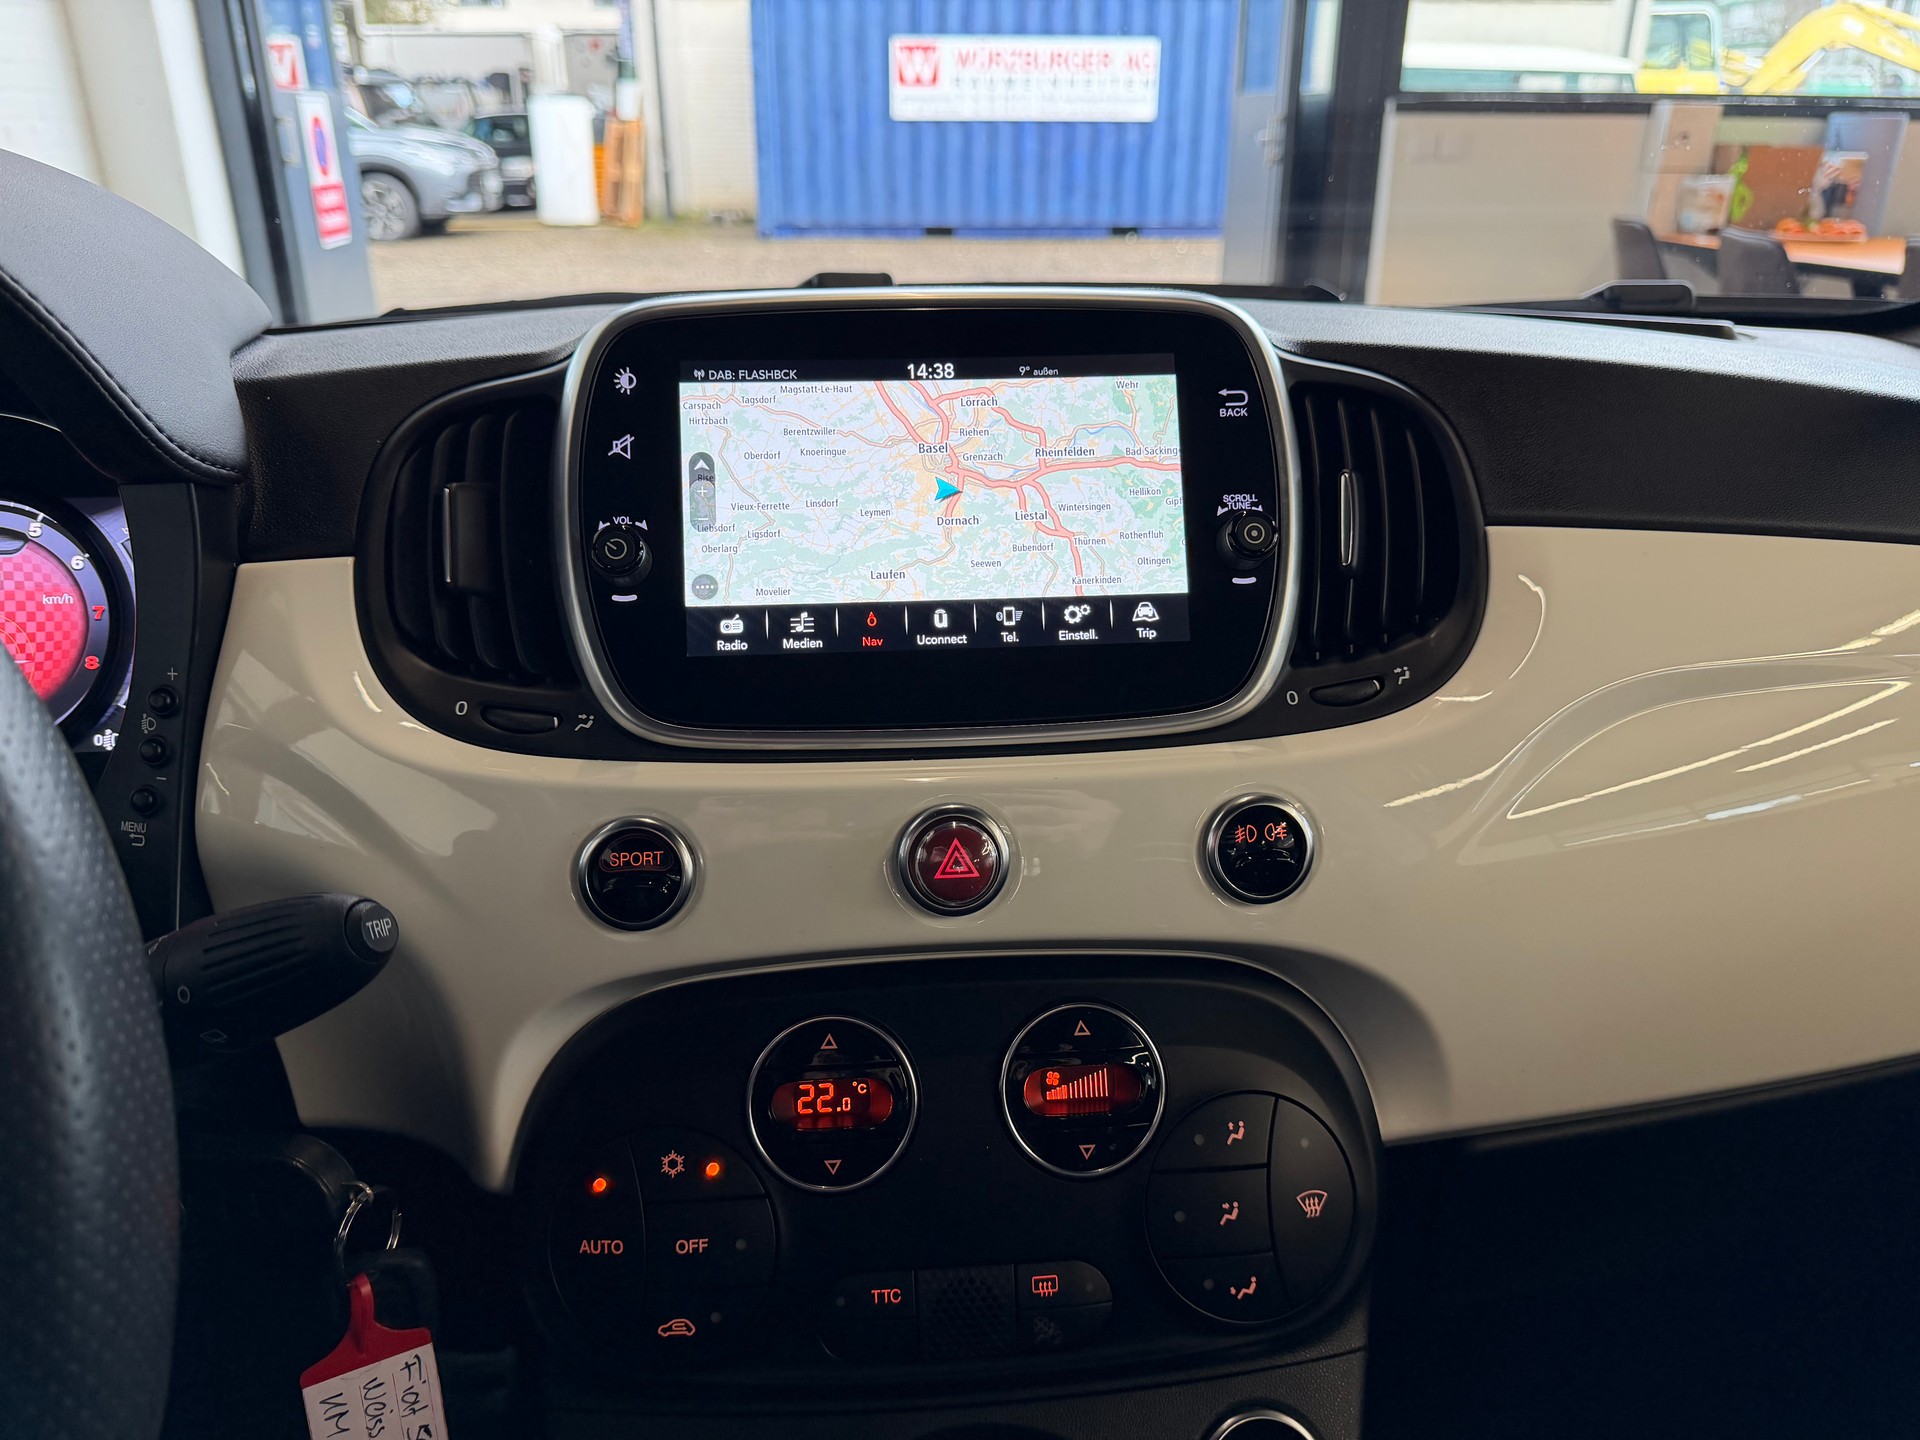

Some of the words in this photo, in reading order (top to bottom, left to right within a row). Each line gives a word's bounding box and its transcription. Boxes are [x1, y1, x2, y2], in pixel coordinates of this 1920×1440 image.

[708, 370, 736, 380] DAB:
[738, 369, 798, 380] FLASHBCK
[907, 362, 955, 379] 14:38
[1018, 366, 1030, 376] 9°
[1033, 366, 1059, 376] außen
[1116, 380, 1139, 389] Wehr
[780, 385, 852, 395] Magstatt-Le-Haut
[741, 395, 776, 405] Tagsdorf
[960, 396, 998, 407] Lörrach
[682, 402, 722, 411] Carspach
[1219, 408, 1248, 418] BACK
[688, 416, 728, 426] Hirtzbach
[783, 427, 836, 436] Berentzwiller
[959, 428, 990, 437] Riehen
[800, 448, 847, 458] Knoeringue
[918, 442, 948, 454] Basel
[1035, 447, 1095, 458] Rheinfelden
[1125, 446, 1142, 456] Bad
[744, 451, 781, 460] Oberdorf
[962, 452, 1003, 461] Grenzach
[1129, 487, 1162, 496] Hellikon
[1222, 494, 1258, 502] SCROLL
[730, 502, 790, 512] Vieux-Ferrette
[806, 499, 839, 508] Linsdorf
[1058, 502, 1111, 513] Wintersingen
[1227, 501, 1252, 510] TUNE
[860, 508, 891, 518] Leymen
[1015, 510, 1048, 522] Liestal
[612, 516, 632, 525] VOL
[936, 516, 980, 526] Dornach
[28, 522, 43, 537] 5
[747, 530, 781, 540] Ligsdorf
[1119, 531, 1164, 540] Rothenfluh
[1074, 536, 1106, 546] Thürnen
[702, 544, 738, 554] Oberlarg
[1012, 543, 1054, 552] Bubendorf
[70, 555, 85, 570] 6
[970, 559, 1002, 568] Seewen
[1137, 556, 1171, 566] Oltingen
[870, 570, 906, 580] Laufen
[755, 588, 791, 596] Movelier
[42, 594, 74, 605] km/h
[92, 606, 106, 620] 7
[1001, 632, 1020, 642] Tel.
[1059, 630, 1098, 641] Einstell.
[1136, 628, 1157, 640] Trip
[783, 638, 823, 649] Medien
[862, 637, 884, 646] Nav
[917, 634, 968, 646] Uconnect
[717, 640, 748, 651] Radio
[84, 655, 100, 670] 8
[120, 820, 147, 834] MENU
[609, 850, 664, 867] SPORT
[366, 917, 392, 940] TRIP
[798, 1082, 851, 1114] 22.0
[579, 1240, 624, 1254] AUTO
[675, 1238, 709, 1254] OFF
[871, 1290, 901, 1304] TTC
[400, 1354, 428, 1418] Fiat
